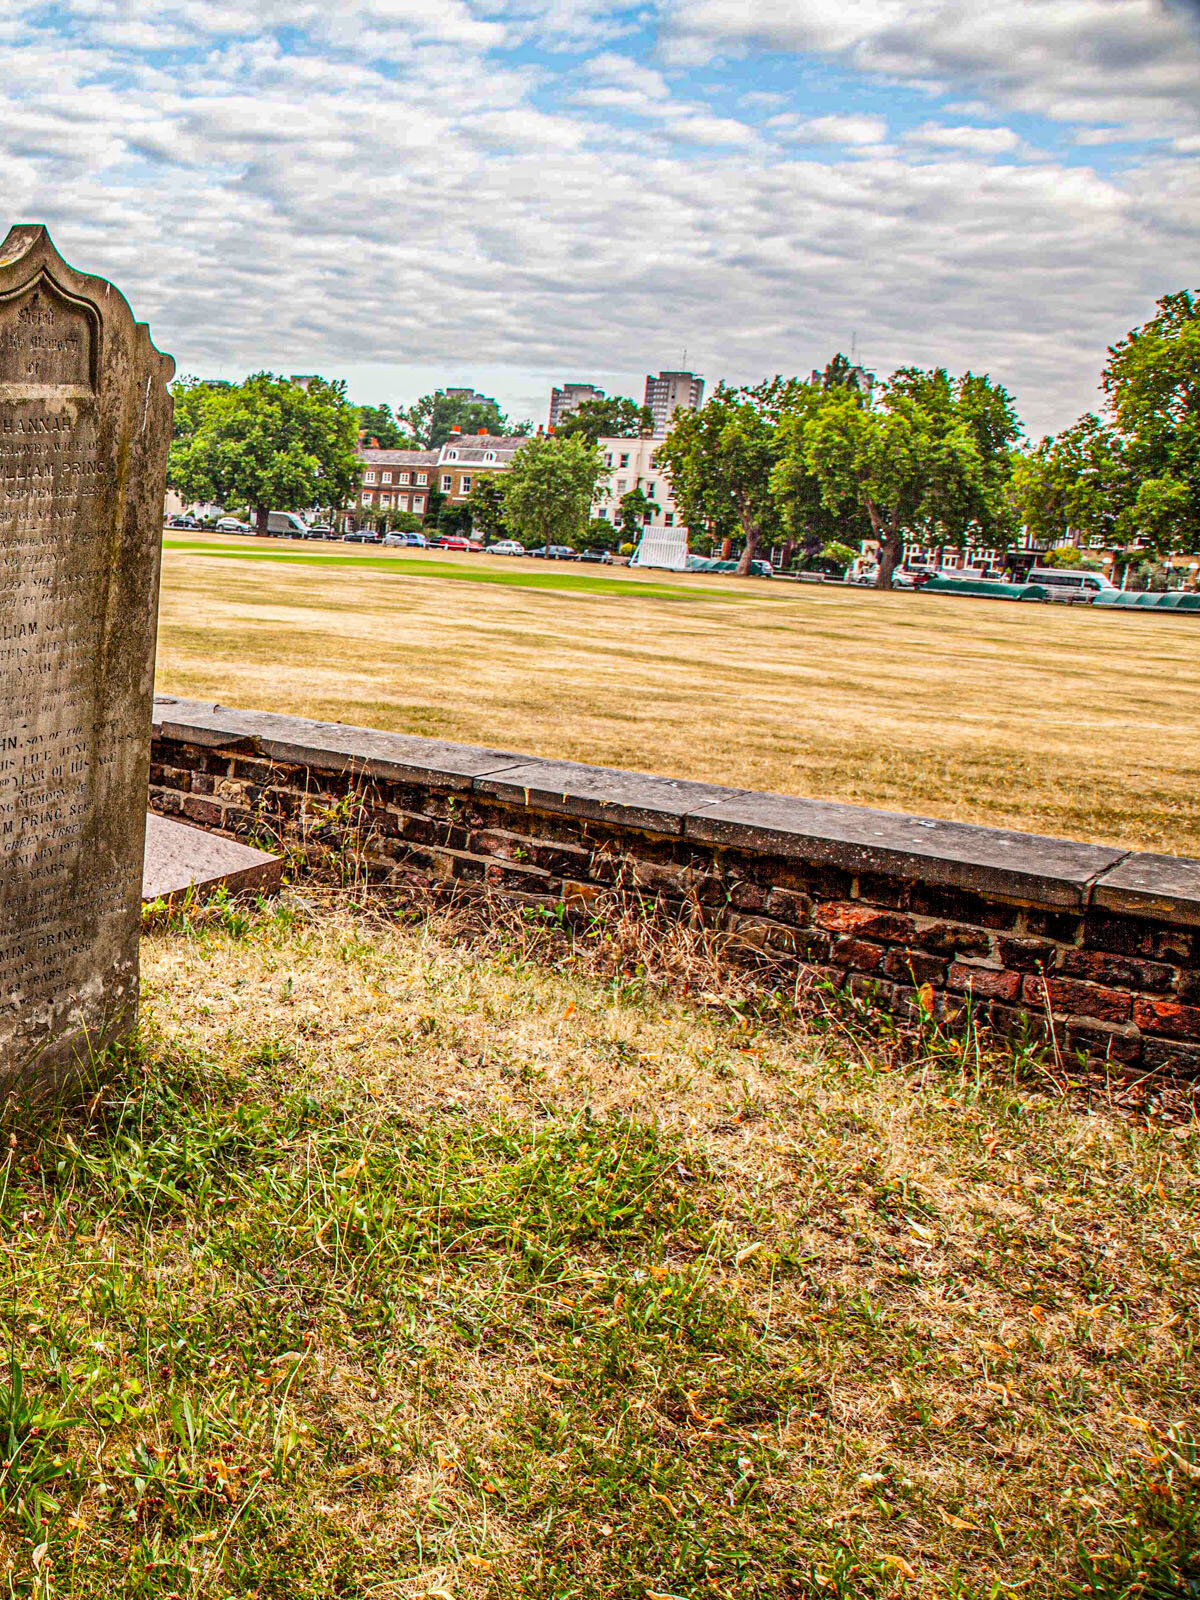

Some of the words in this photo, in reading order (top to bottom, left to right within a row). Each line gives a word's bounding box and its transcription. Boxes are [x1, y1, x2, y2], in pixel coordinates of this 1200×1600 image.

[22, 749, 52, 766] LIFE
[11, 767, 46, 788] YEAR
[51, 764, 66, 778] OF
[19, 787, 67, 810] MEMORY
[1, 847, 57, 870] JANUARY
